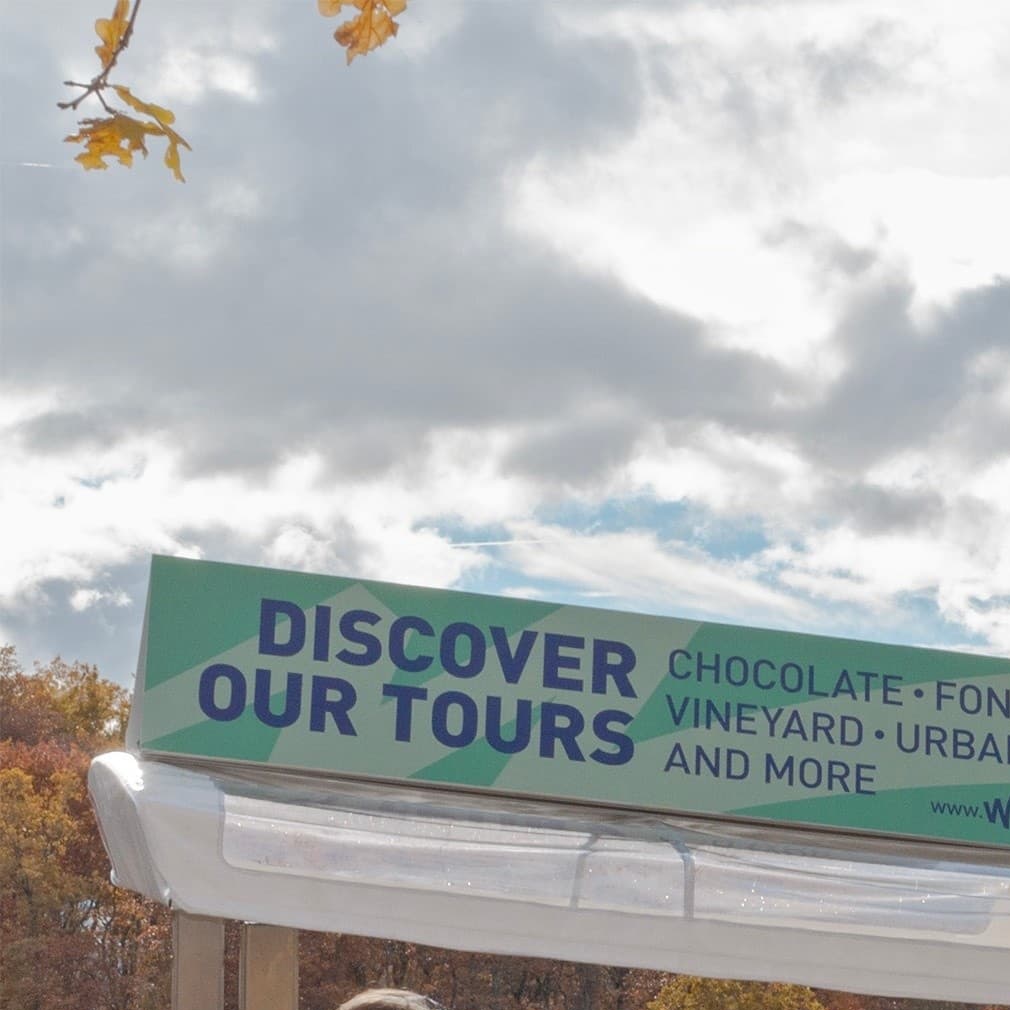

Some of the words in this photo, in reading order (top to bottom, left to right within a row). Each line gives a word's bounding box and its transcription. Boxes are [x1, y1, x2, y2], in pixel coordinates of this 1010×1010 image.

[257, 598, 638, 700] DISCOVER
[667, 649, 904, 707] CHOCOLATE
[197, 662, 358, 738] OUR
[380, 683, 636, 767] TOURS
[665, 694, 864, 748] VINEYARD
[663, 742, 751, 781] AND
[764, 753, 877, 796] MORE
